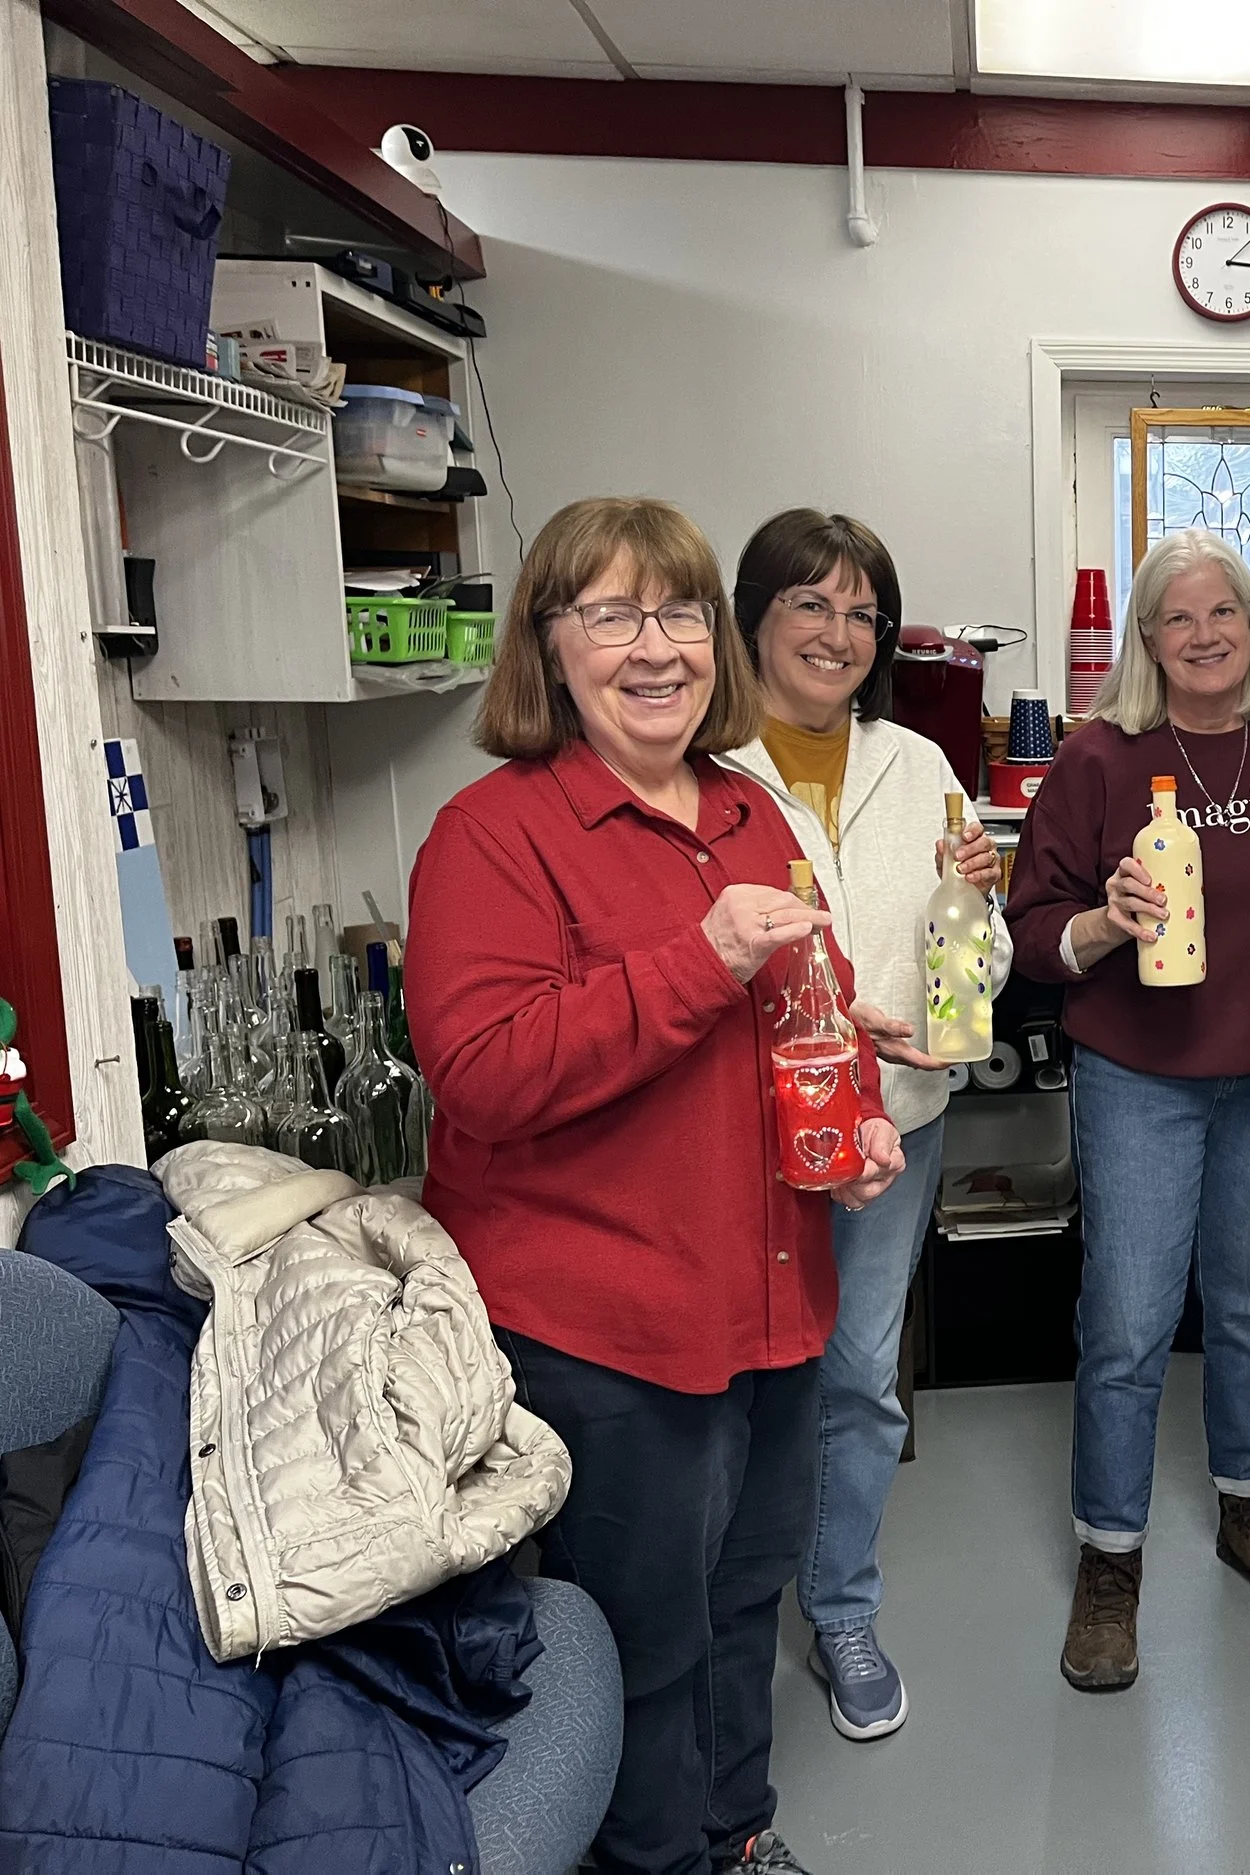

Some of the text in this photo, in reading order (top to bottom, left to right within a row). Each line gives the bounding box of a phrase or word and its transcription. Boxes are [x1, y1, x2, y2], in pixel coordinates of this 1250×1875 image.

[1206, 222, 1213, 235] 11
[1222, 216, 1234, 229] 12
[1191, 237, 1203, 250] 10
[1185, 256, 1193, 269] 9
[1191, 277, 1200, 289] 8
[1206, 291, 1214, 303] 7
[1225, 297, 1233, 309] 6
